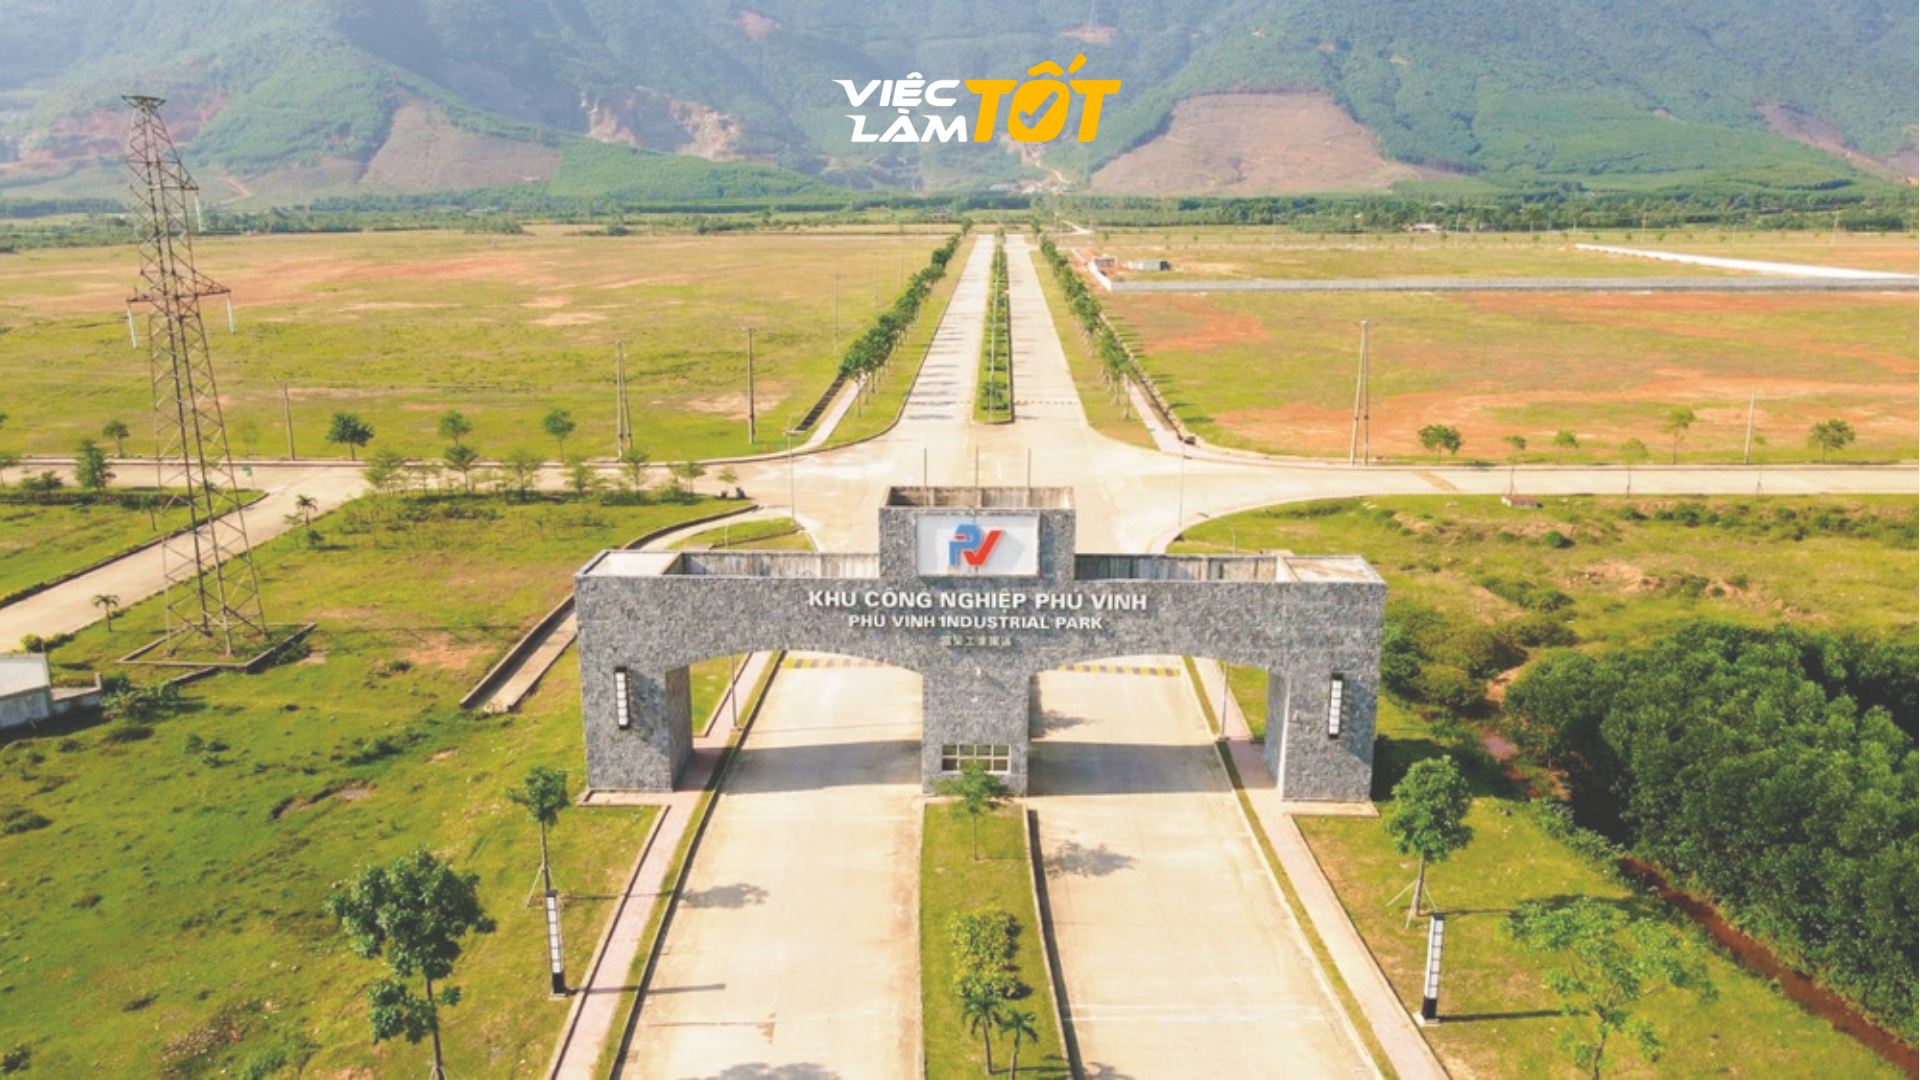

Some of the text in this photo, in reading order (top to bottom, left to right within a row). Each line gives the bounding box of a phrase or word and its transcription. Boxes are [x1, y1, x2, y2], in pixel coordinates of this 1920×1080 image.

[808, 590, 857, 608] KHU
[864, 587, 933, 609] CÔNG
[940, 588, 1027, 614] NGHIỆP
[1090, 592, 1147, 611] VINH
[891, 614, 935, 628] VINH
[939, 615, 1050, 630] INDUSTRIAL
[1054, 616, 1103, 630] PARK
